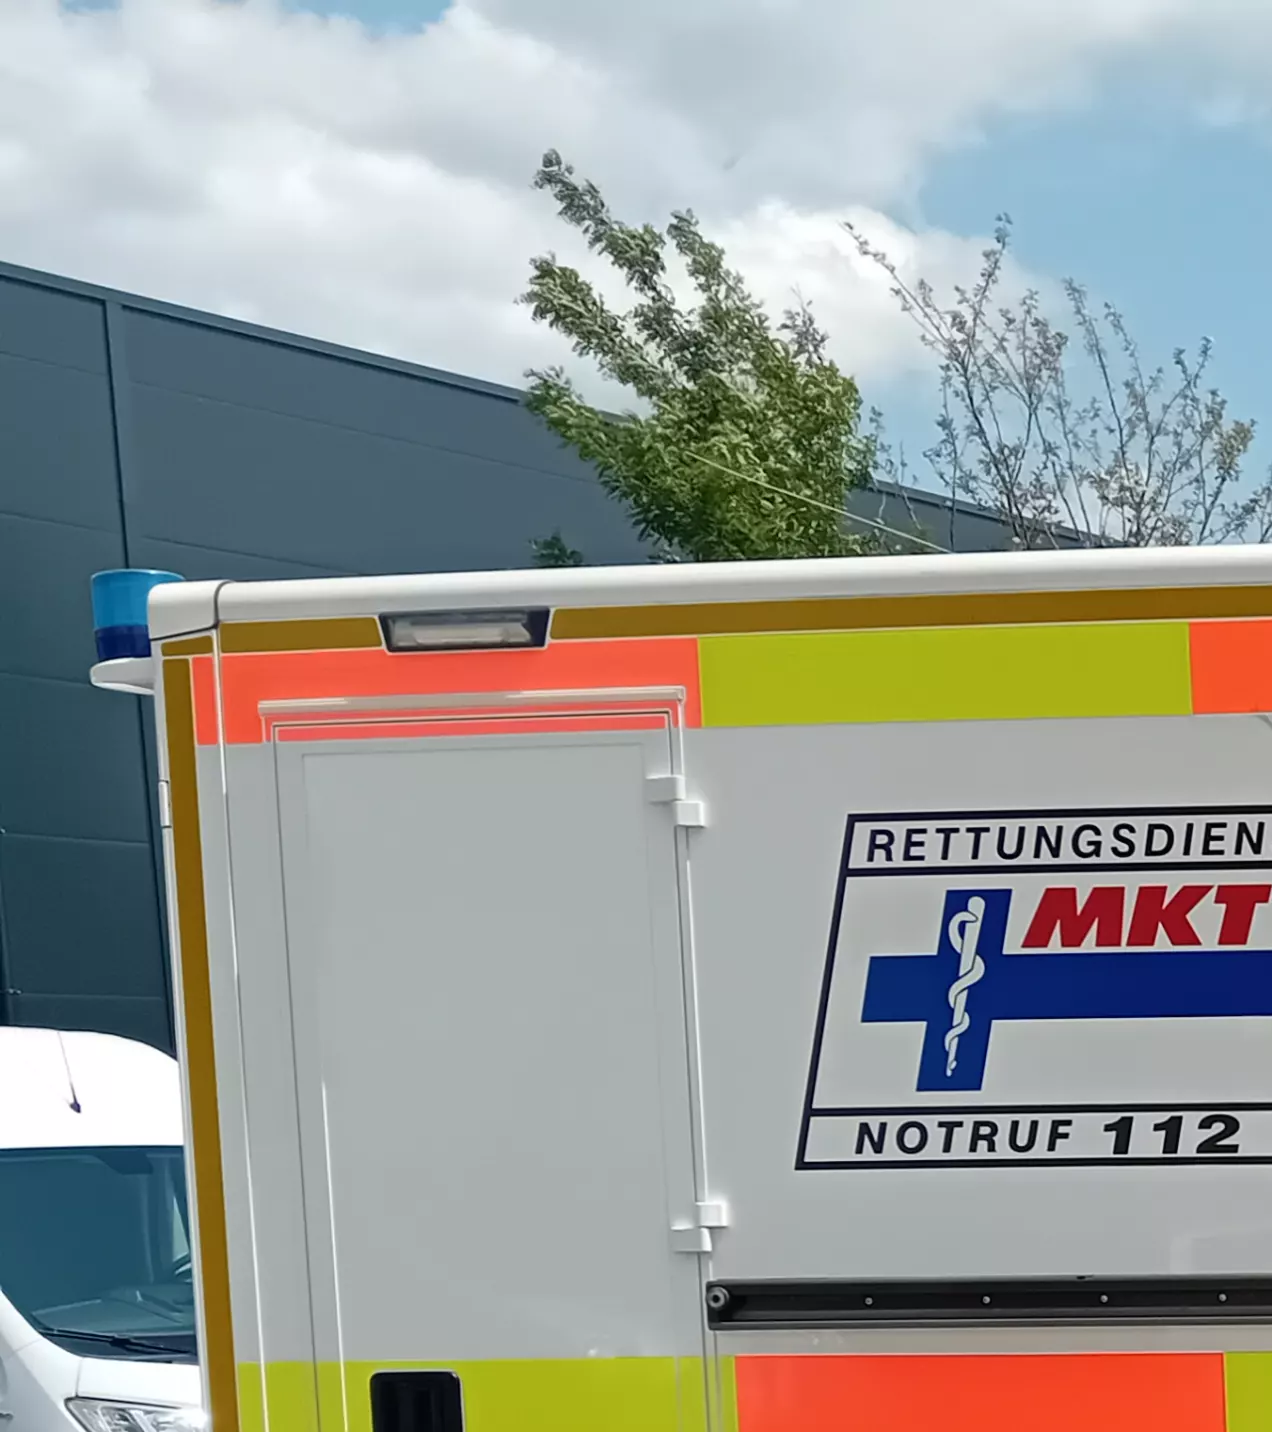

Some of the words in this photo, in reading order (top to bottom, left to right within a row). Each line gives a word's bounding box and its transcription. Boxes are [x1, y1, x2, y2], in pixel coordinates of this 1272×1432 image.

[1020, 883, 1272, 948] MKT
[854, 1118, 1075, 1155] NOTRUF
[1102, 1113, 1241, 1156] 112
